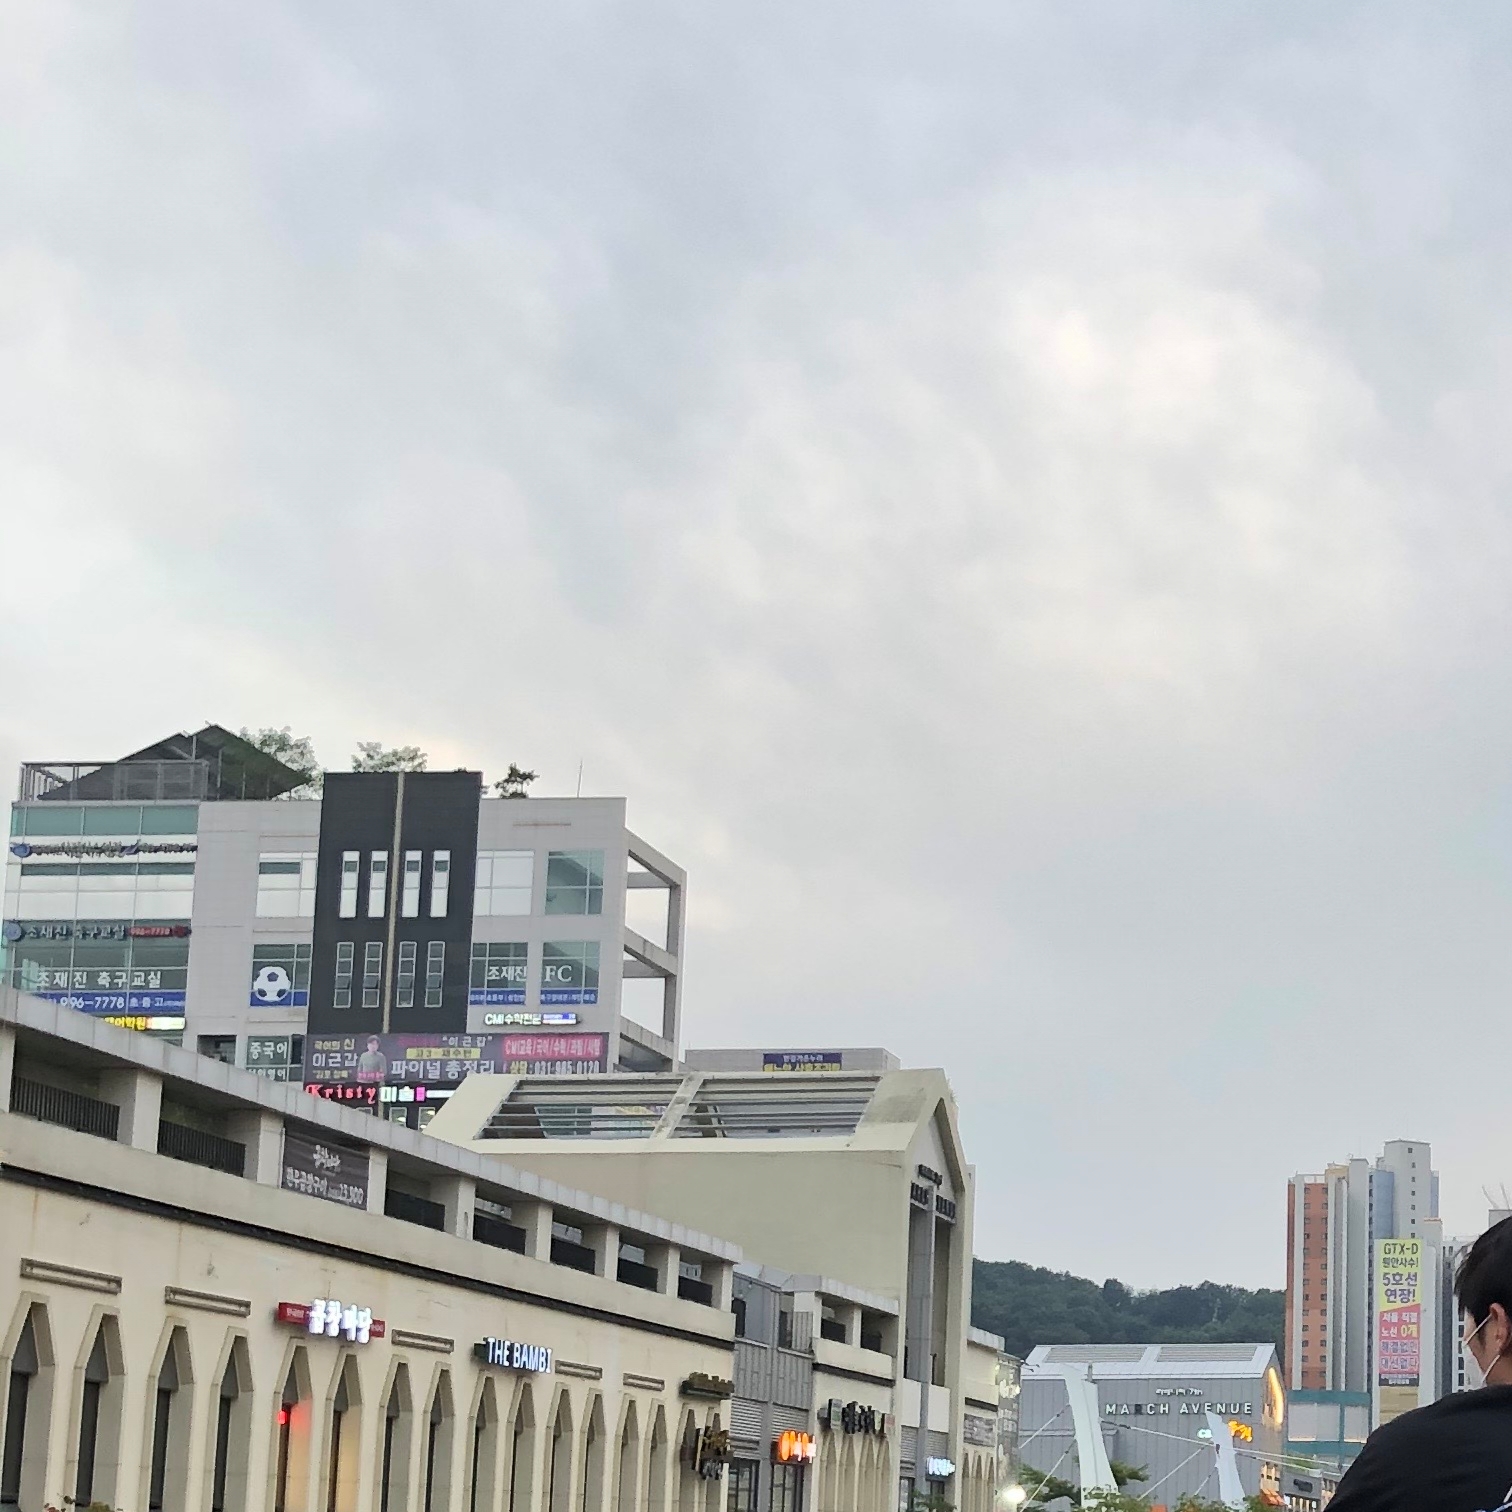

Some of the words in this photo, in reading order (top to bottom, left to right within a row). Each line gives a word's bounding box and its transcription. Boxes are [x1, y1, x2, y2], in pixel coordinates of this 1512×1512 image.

[37, 971, 87, 988] 조재진
[97, 970, 162, 988] 축구교실
[486, 965, 528, 982] 조재진
[545, 965, 572, 982] FC
[60, 996, 125, 1009] 996-7778
[250, 1041, 288, 1060] 중국어
[312, 1052, 359, 1067] 이근갑
[391, 1060, 441, 1079] 파이널
[305, 1083, 376, 1104] Kristy
[1383, 1242, 1419, 1255] GTX-D
[1382, 1271, 1418, 1287] 5호선
[1384, 1288, 1416, 1304] 연장!
[487, 1337, 511, 1367] THE
[513, 1342, 553, 1374] BAMBI
[1105, 1403, 1170, 1415] MARCH
[1179, 1402, 1253, 1415] AVENUE
